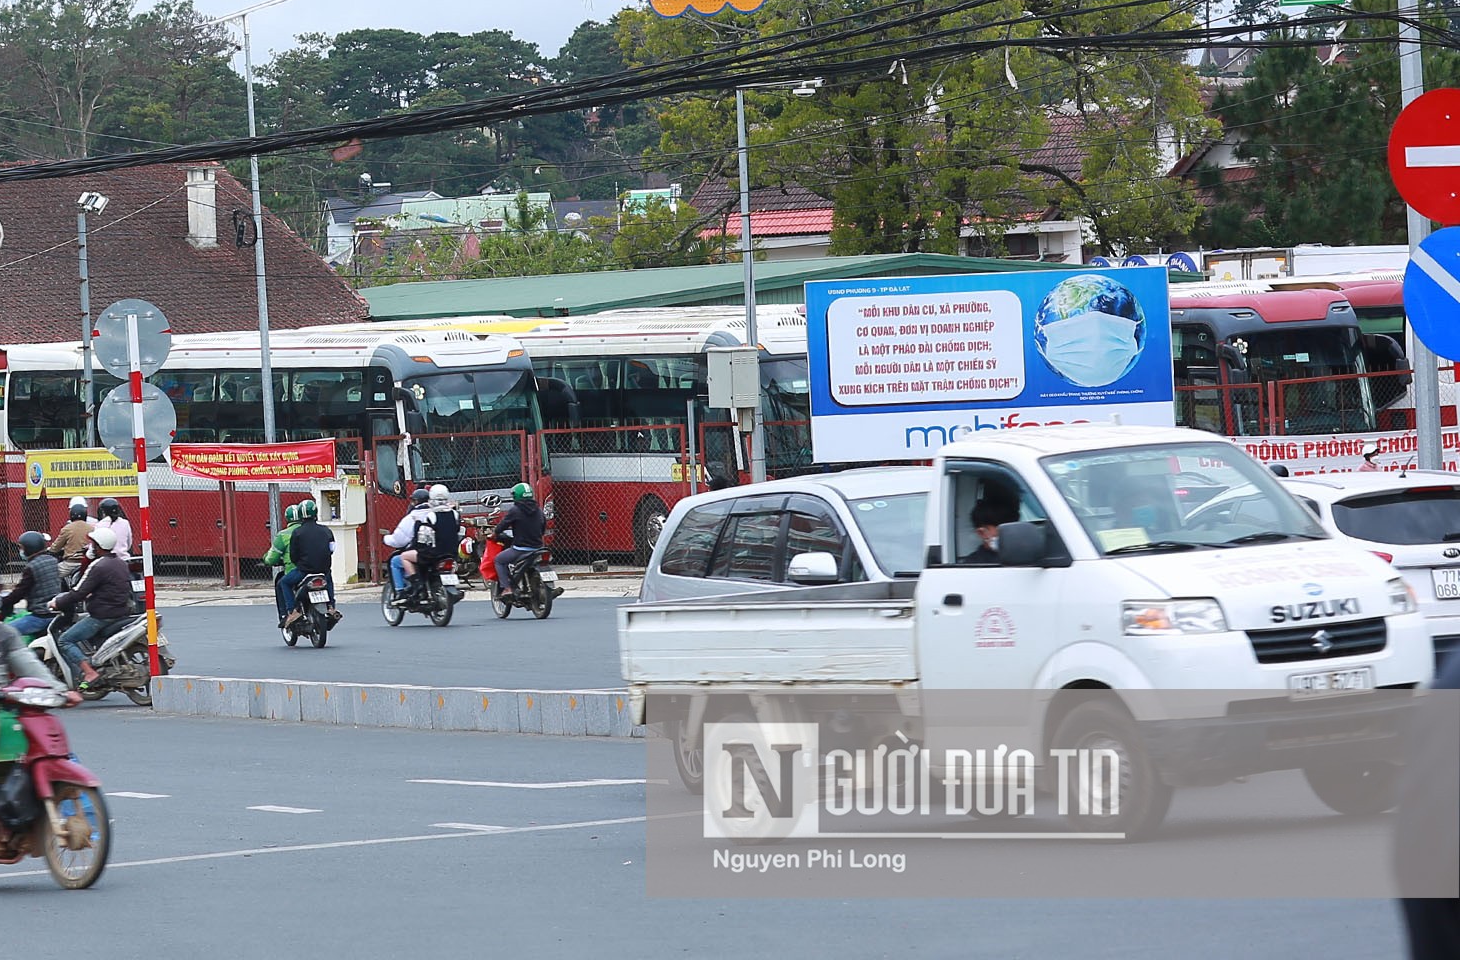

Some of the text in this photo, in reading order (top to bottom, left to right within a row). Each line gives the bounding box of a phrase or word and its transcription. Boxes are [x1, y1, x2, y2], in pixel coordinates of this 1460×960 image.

[883, 306, 900, 317] KHU
[903, 304, 920, 316] DÂN
[871, 326, 897, 338] QUAN,
[931, 323, 960, 334] DOANH
[963, 319, 995, 334] NGHIỆP
[859, 344, 869, 356] LÀ
[872, 343, 890, 357] MỘT
[935, 339, 965, 353] CHỐNG
[923, 360, 934, 372] LÀ
[936, 359, 955, 374] MỘT
[957, 357, 984, 371] CHIẾN
[839, 384, 862, 395] XUNG
[887, 380, 908, 393] TRÊN
[957, 376, 986, 390] CHỐNG
[1270, 597, 1360, 623] SUZUKI
